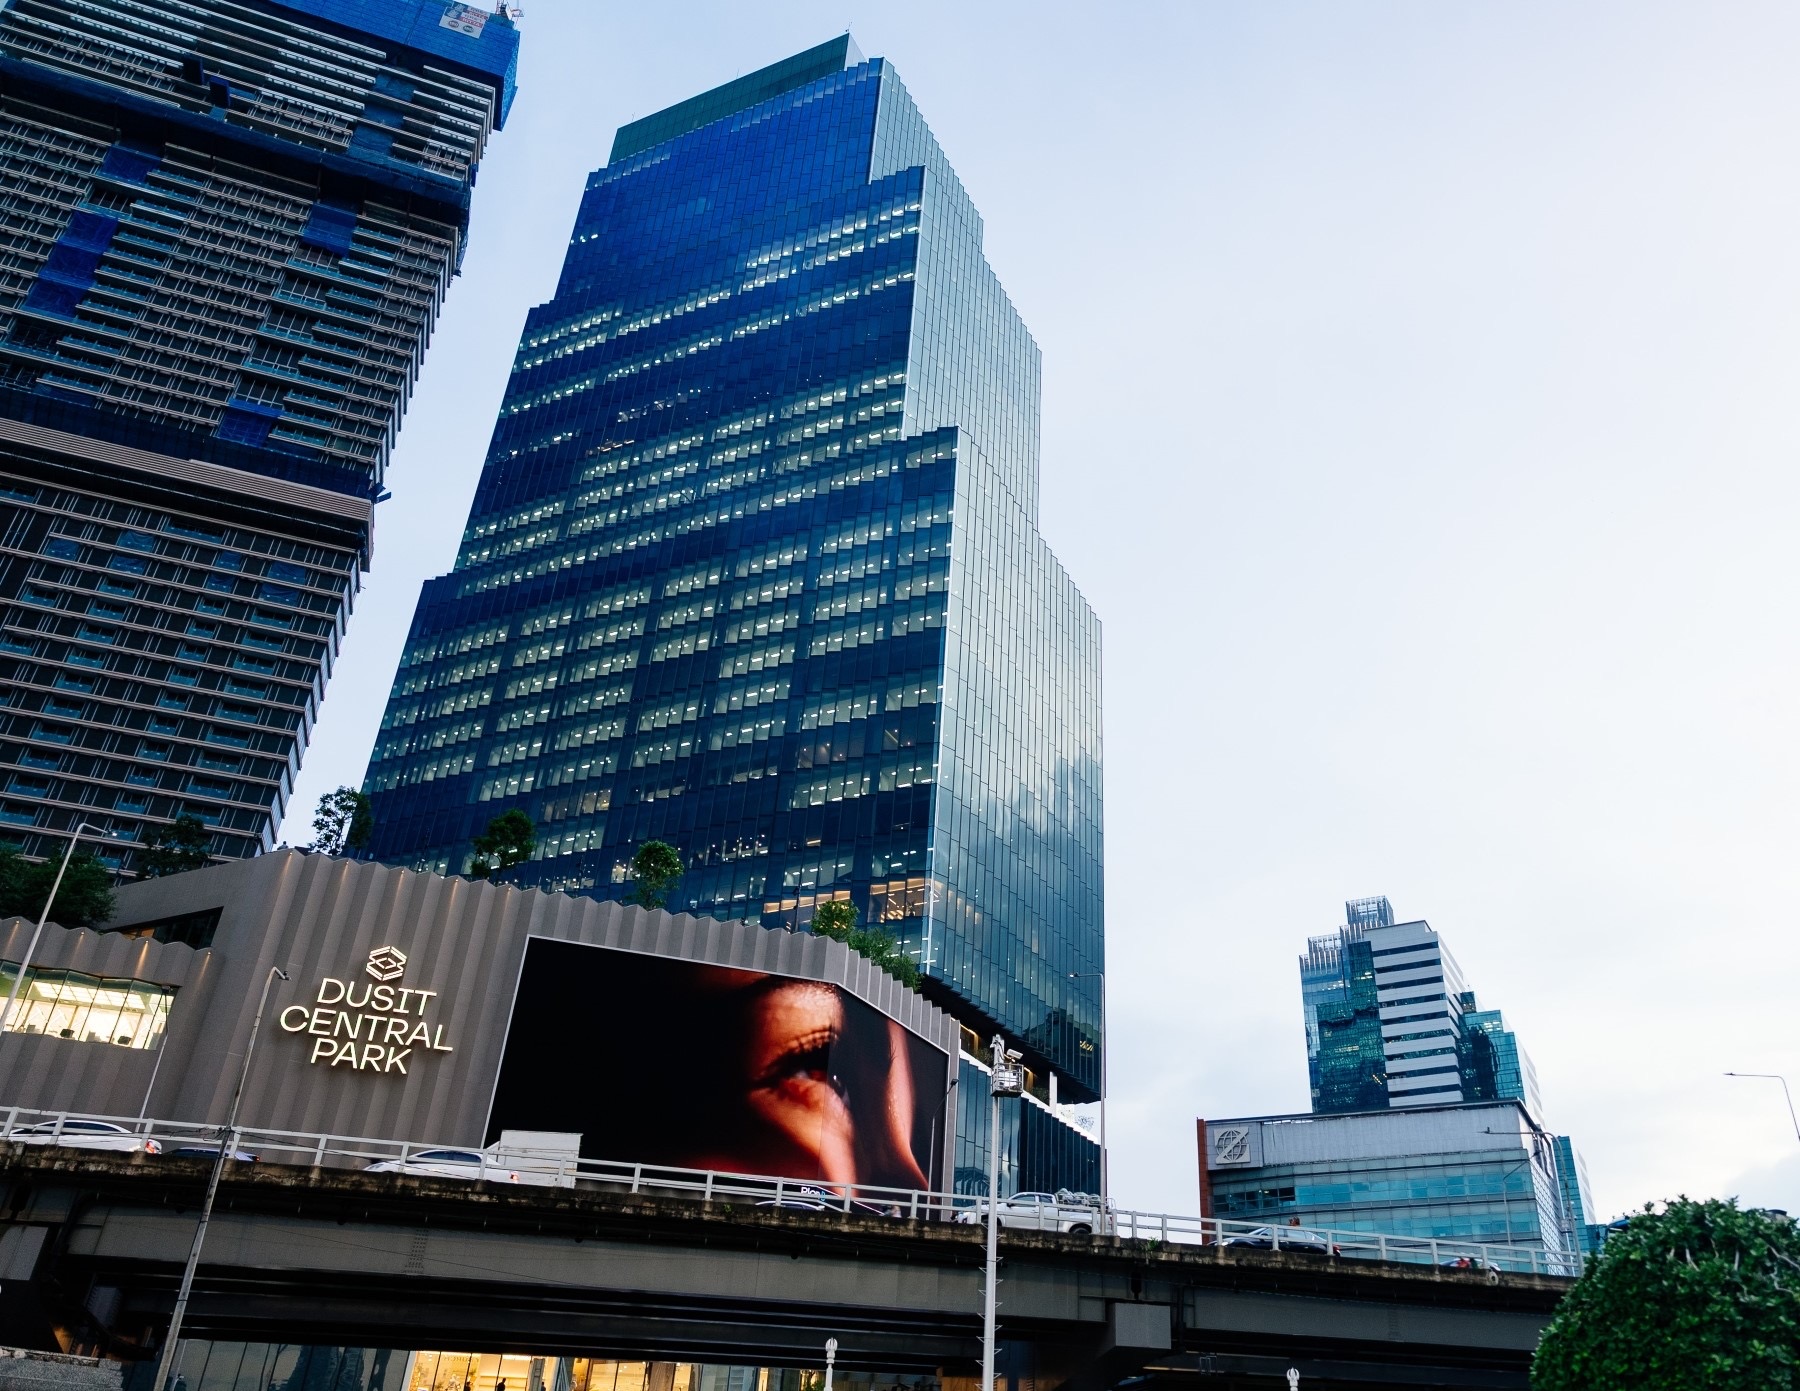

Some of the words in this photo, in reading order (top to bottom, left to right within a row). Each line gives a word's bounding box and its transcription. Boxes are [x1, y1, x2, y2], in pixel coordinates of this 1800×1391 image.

[316, 977, 438, 1016] DUSIT
[279, 1005, 454, 1052] CENTRAL
[310, 1037, 413, 1075] PARK
